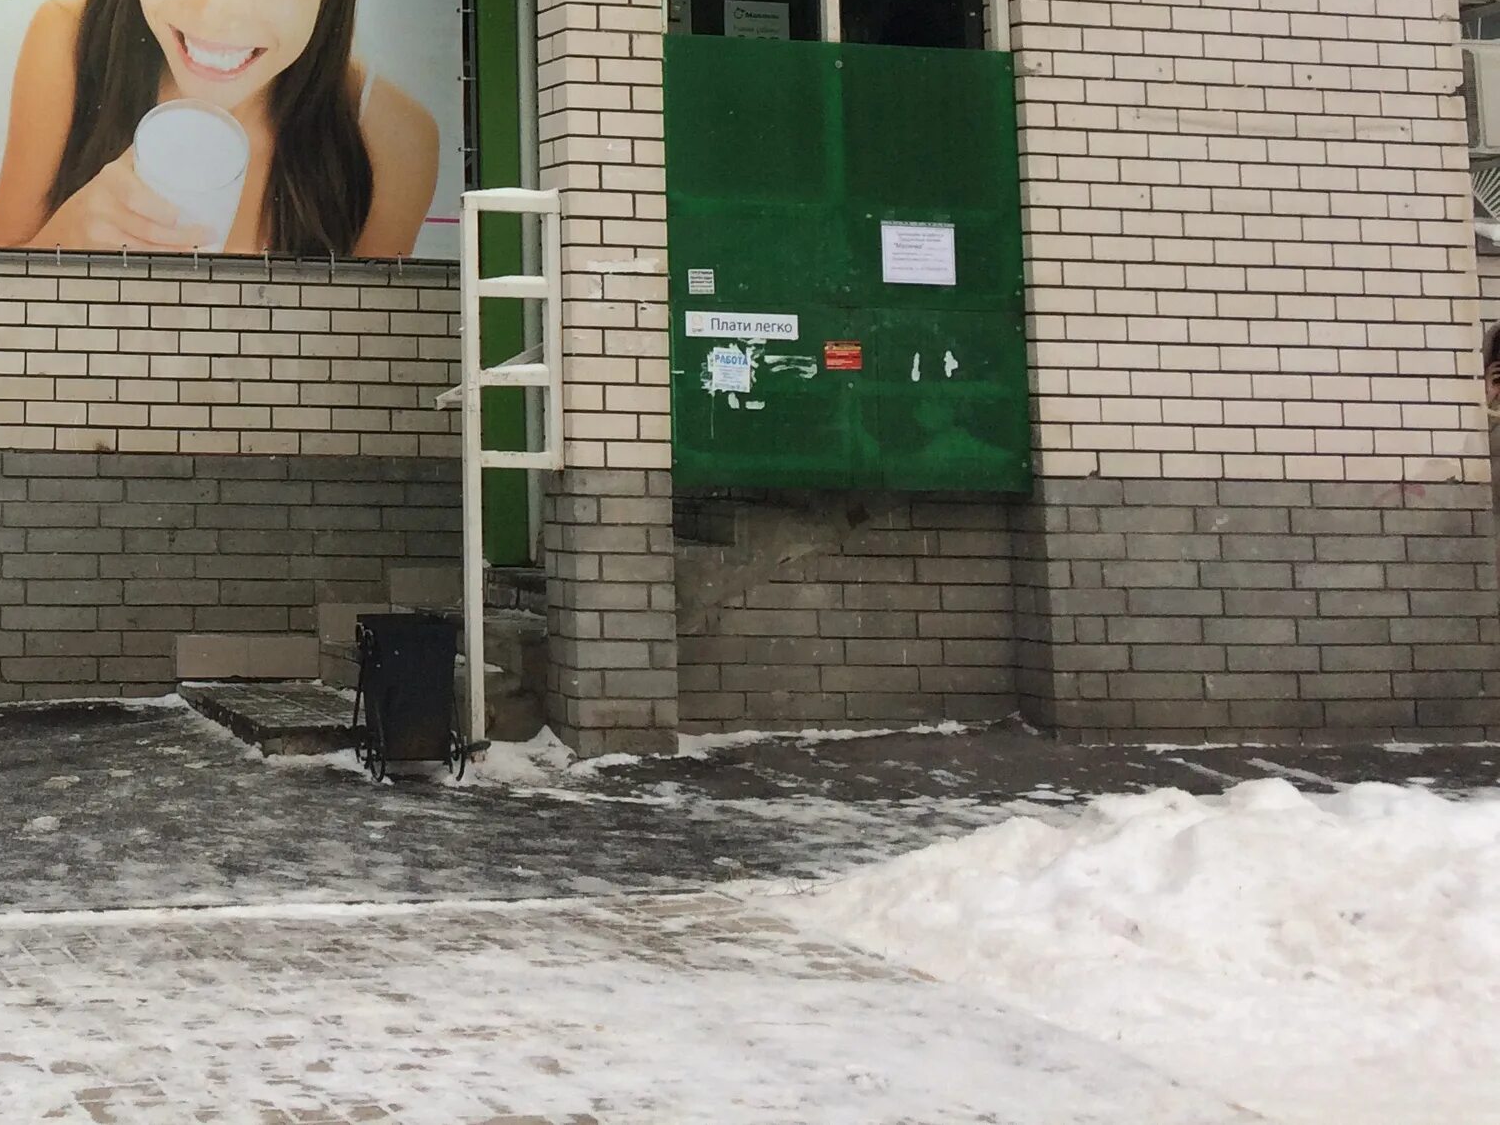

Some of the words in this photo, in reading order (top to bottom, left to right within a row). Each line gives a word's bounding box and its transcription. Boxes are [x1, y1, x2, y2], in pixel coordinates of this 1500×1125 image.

[710, 317, 751, 332] Плати
[755, 321, 793, 333] легко
[714, 354, 749, 366] РАБОТА
